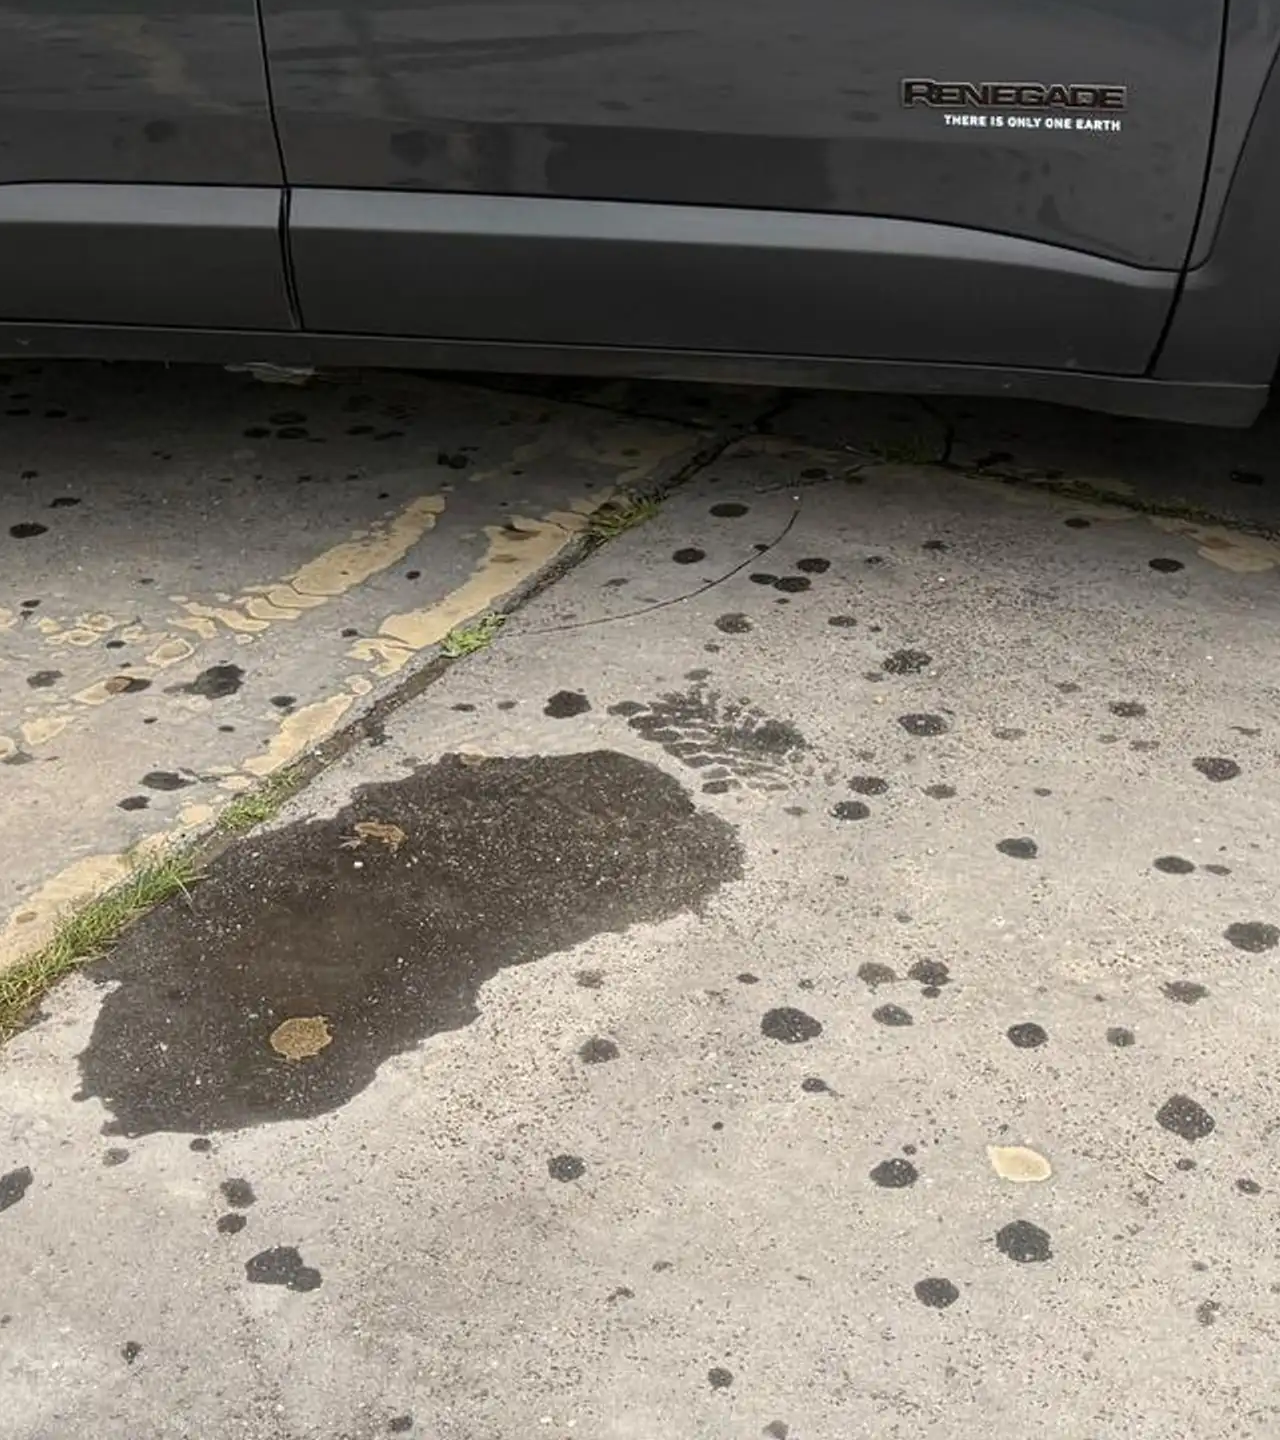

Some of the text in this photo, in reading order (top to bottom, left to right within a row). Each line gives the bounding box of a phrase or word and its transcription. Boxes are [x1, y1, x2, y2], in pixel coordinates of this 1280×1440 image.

[901, 78, 1127, 110] RENEGADE
[943, 114, 1121, 132] THERE IS ONLY ONE EARTH
